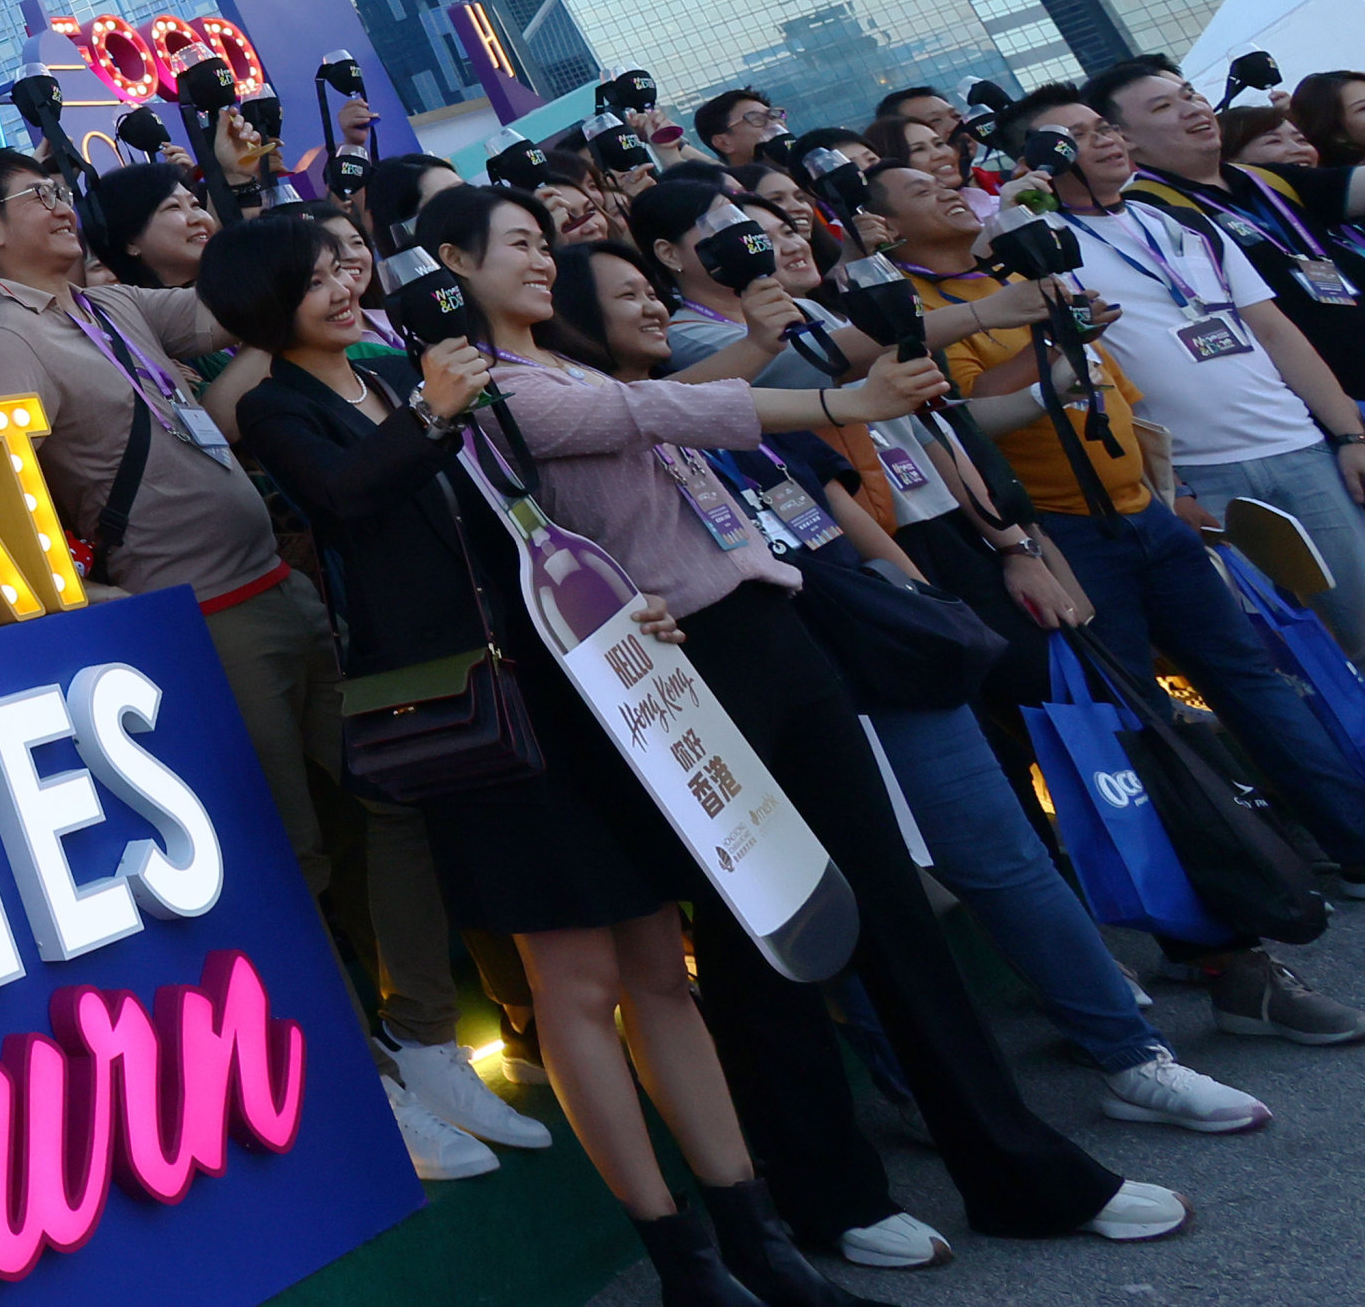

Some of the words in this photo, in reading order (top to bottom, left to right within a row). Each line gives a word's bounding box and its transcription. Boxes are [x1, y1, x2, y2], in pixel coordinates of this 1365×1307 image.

[604, 633, 654, 690] HELLO
[618, 692, 671, 753] Hong
[651, 667, 700, 722] Kong
[670, 727, 707, 773] 你好
[687, 755, 743, 820] 香港
